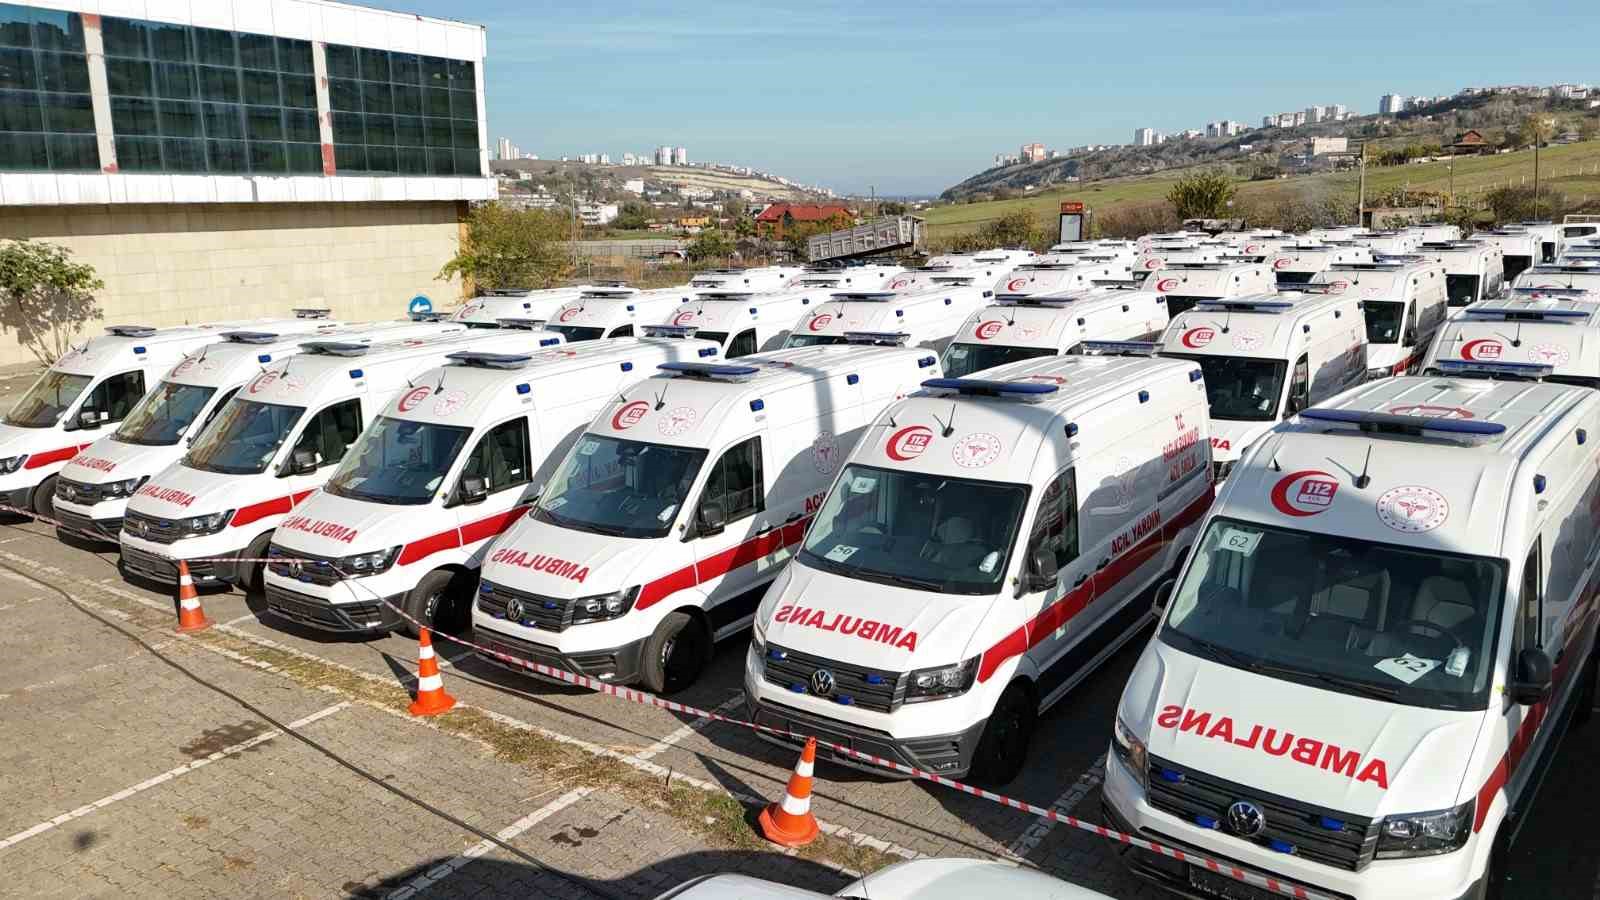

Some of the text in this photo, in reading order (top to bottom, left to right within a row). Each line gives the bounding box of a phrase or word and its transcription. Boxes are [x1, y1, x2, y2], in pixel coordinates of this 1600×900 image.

[908, 435, 925, 446] 112
[1306, 482, 1332, 496] 112
[1229, 535, 1249, 547] 62
